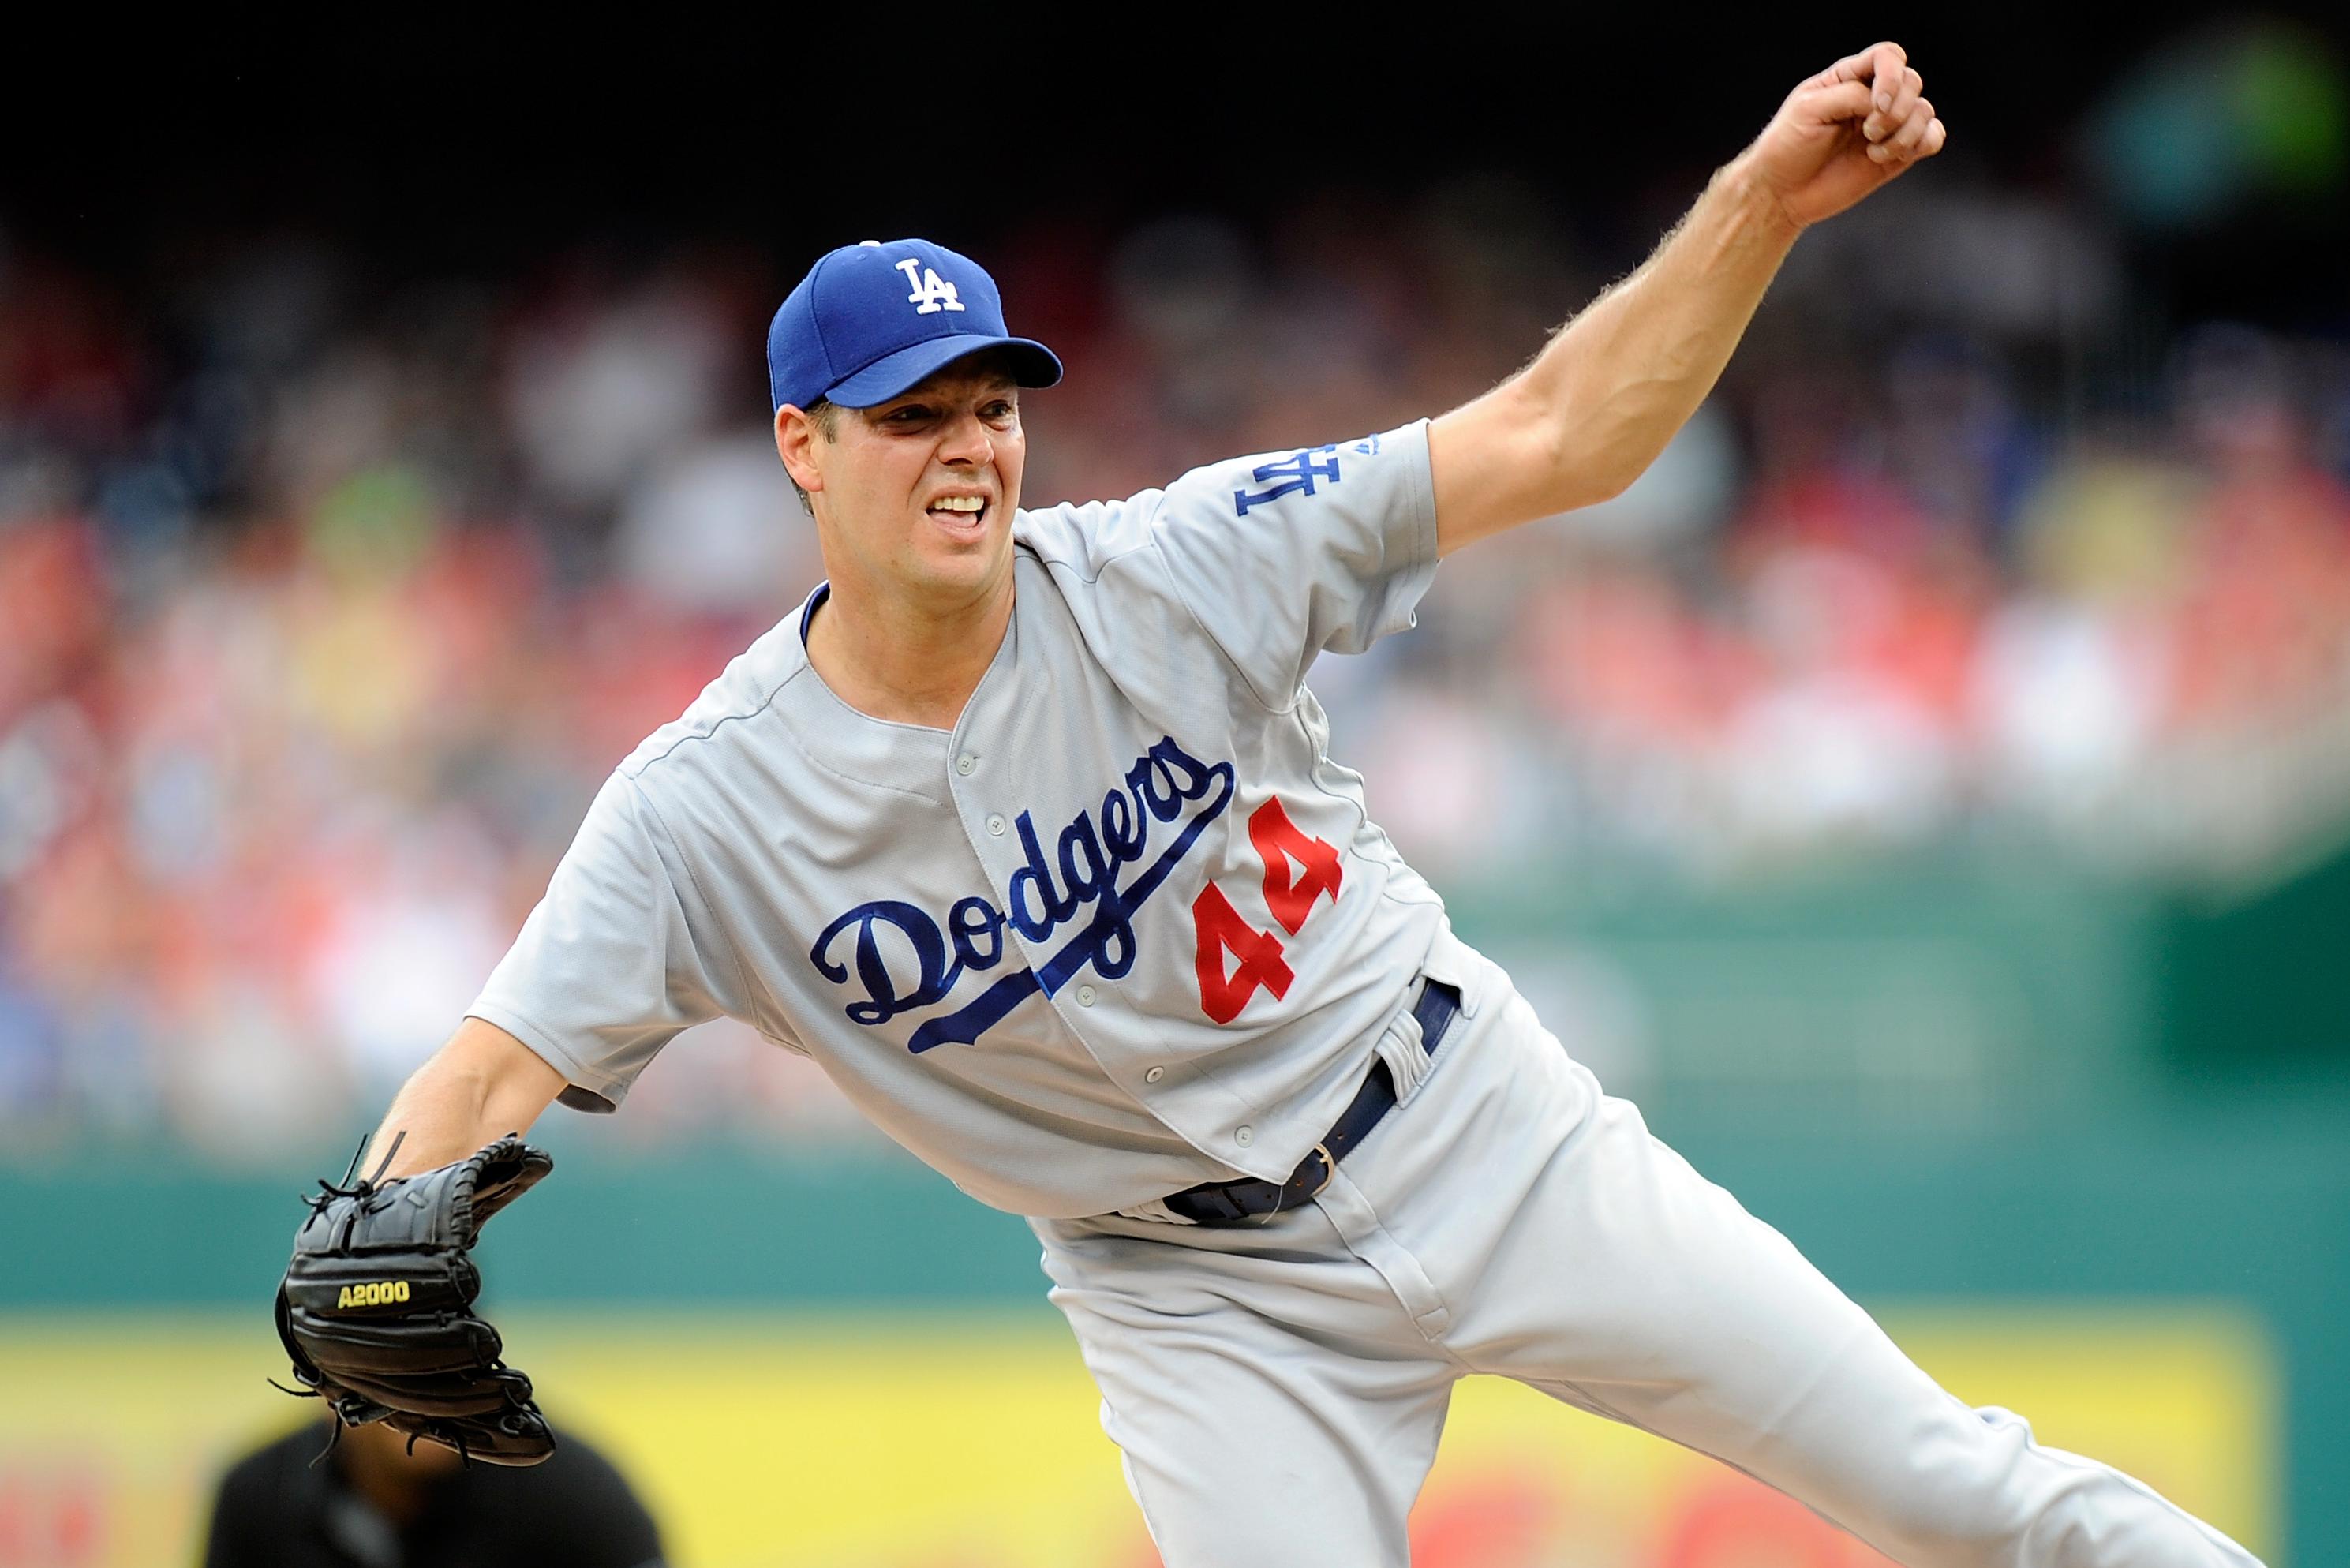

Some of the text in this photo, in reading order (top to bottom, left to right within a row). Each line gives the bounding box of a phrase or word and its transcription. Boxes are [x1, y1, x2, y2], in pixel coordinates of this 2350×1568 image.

[894, 257, 966, 316] LA
[1233, 443, 1341, 517] LA
[810, 735, 1235, 1055] Dodgers
[1192, 794, 1344, 1024] 44
[338, 1281, 410, 1309] A2000
